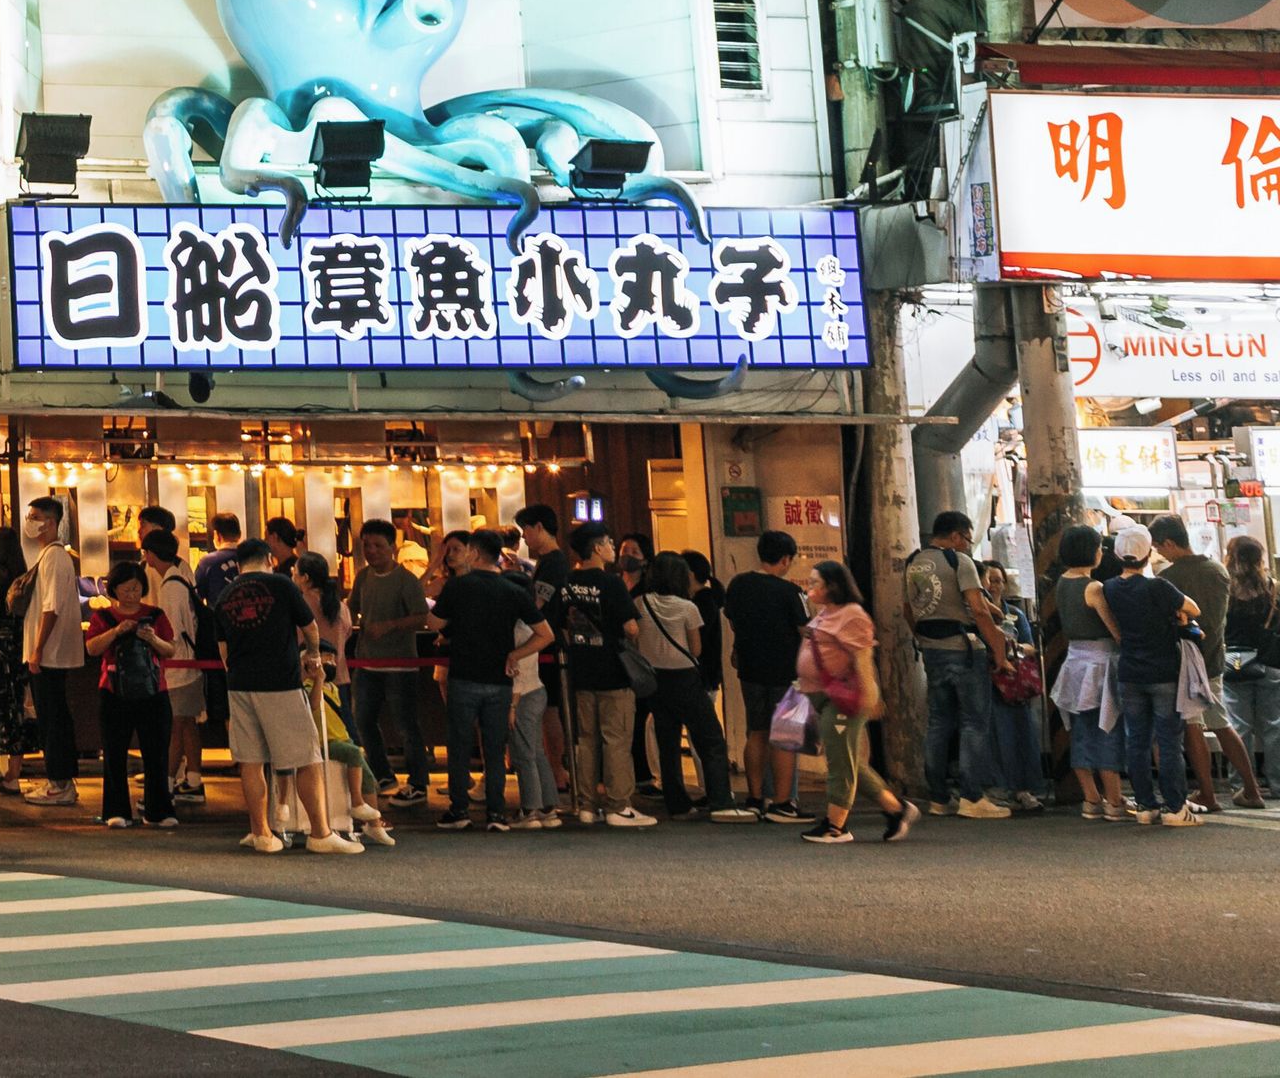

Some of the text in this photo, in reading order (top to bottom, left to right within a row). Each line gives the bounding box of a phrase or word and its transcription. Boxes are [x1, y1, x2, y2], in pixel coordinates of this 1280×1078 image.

[1046, 112, 1280, 210] 明倫
[42, 222, 797, 350] 日船章魚小丸子
[1123, 333, 1268, 358] MINGLUN
[1172, 369, 1202, 382] Less
[1210, 369, 1225, 382] oil
[1233, 369, 1256, 382] and
[783, 499, 824, 525] 誠徵
